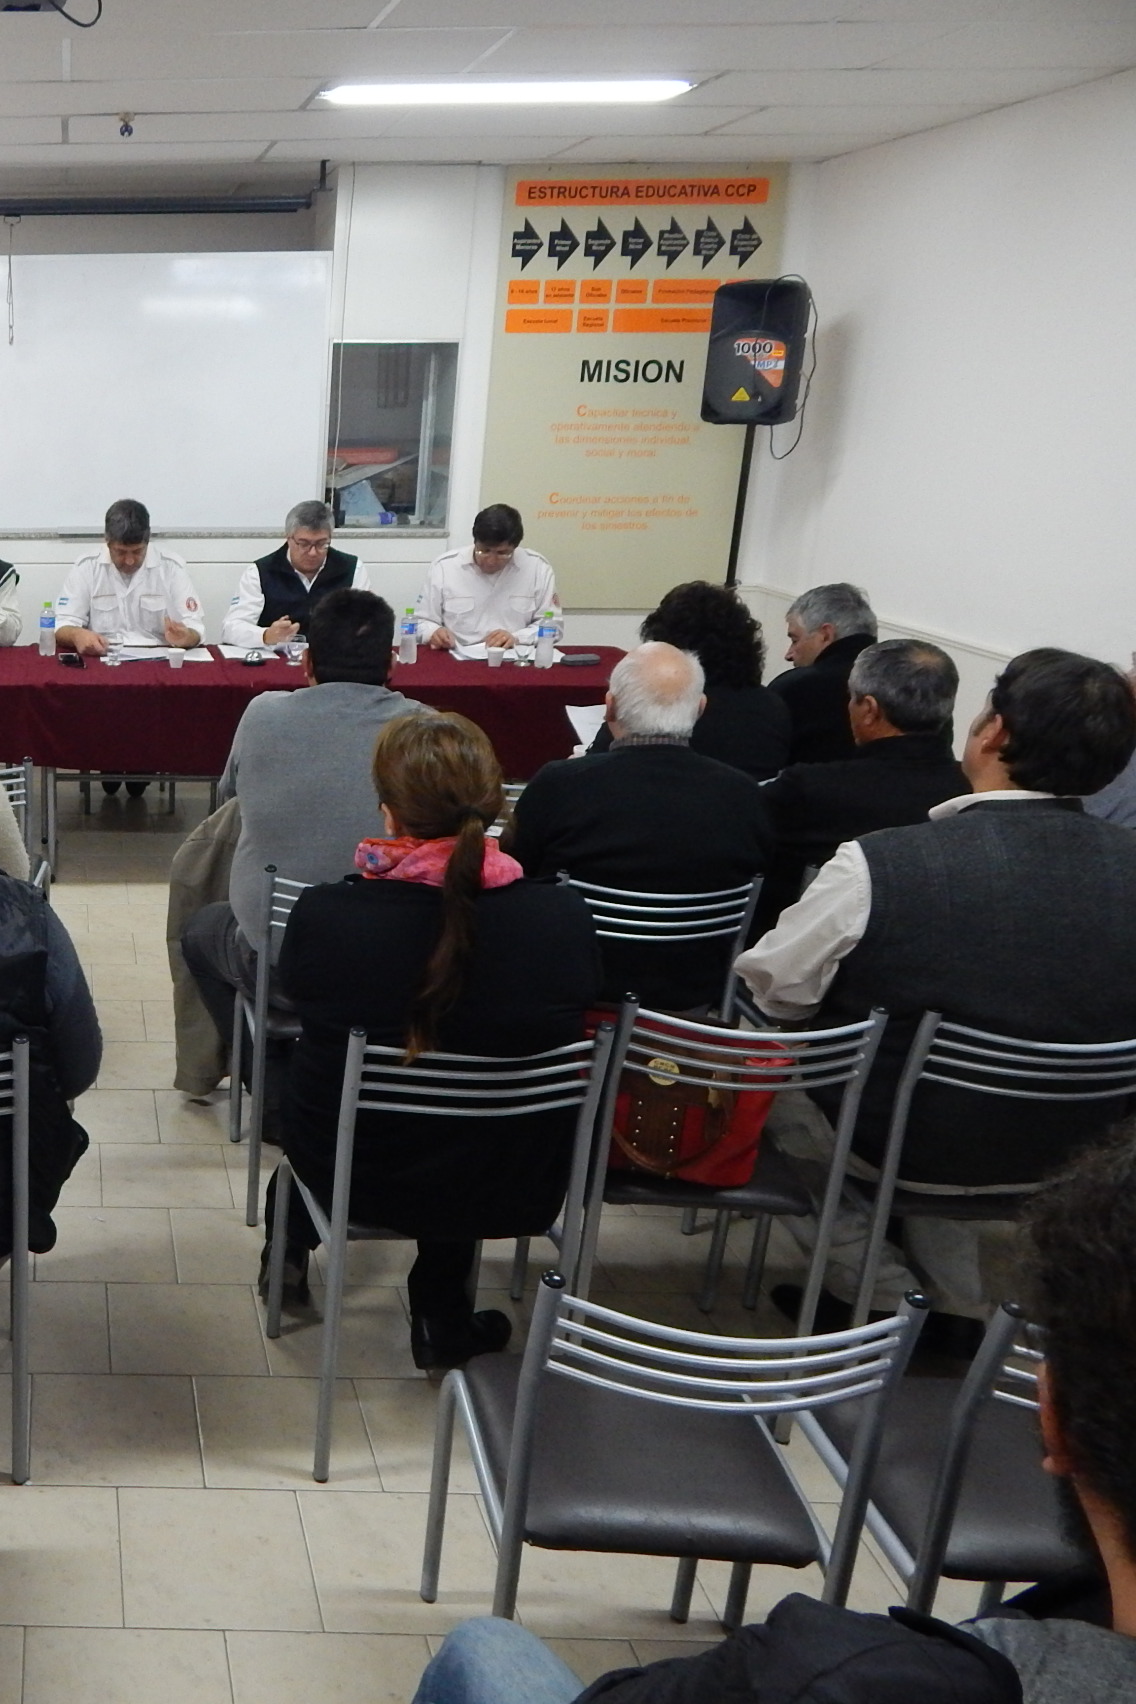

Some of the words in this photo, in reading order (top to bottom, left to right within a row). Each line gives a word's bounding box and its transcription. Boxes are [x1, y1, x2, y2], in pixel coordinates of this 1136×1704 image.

[528, 185, 630, 200] ESTRUCTURA
[635, 184, 720, 198] EDUCATIVA
[724, 184, 757, 198] CCP
[734, 342, 774, 354] 1000
[580, 359, 685, 383] MISION
